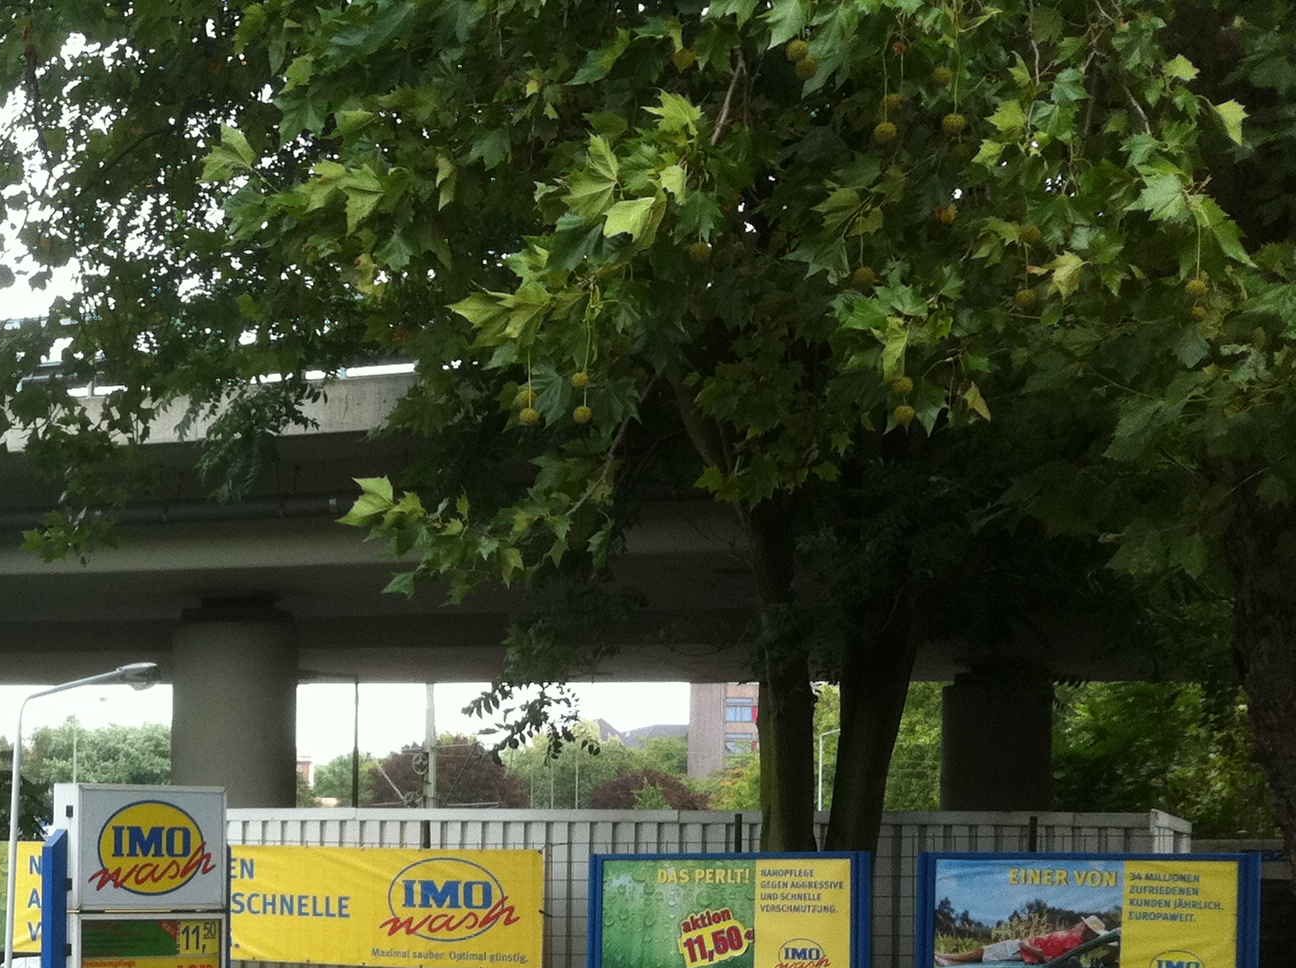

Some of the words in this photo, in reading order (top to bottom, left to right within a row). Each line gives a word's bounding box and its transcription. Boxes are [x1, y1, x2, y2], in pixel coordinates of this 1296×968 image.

[112, 825, 191, 858] IMO
[88, 841, 216, 891] wash
[658, 868, 690, 884] DAS
[695, 868, 750, 884] PERLT!
[760, 880, 788, 889] GEGEN
[790, 881, 844, 890] AGGRESSIVE
[1009, 868, 1069, 887] EINER
[1074, 870, 1119, 887] VON
[1145, 873, 1200, 883] MILLIONEN
[402, 879, 493, 910] IMO
[781, 893, 822, 902] SCHNELLE
[1129, 885, 1200, 896] ZUFRIEDENEN
[231, 892, 351, 918] SCHNELLE
[1129, 898, 1171, 908] KUNDEN
[379, 895, 520, 936] wash
[682, 909, 732, 934] aktion
[683, 925, 744, 963] 11,50
[371, 947, 410, 959] Maximal
[449, 951, 487, 963] Optimal
[489, 953, 529, 964] günstig.
[784, 947, 821, 961] IMO
